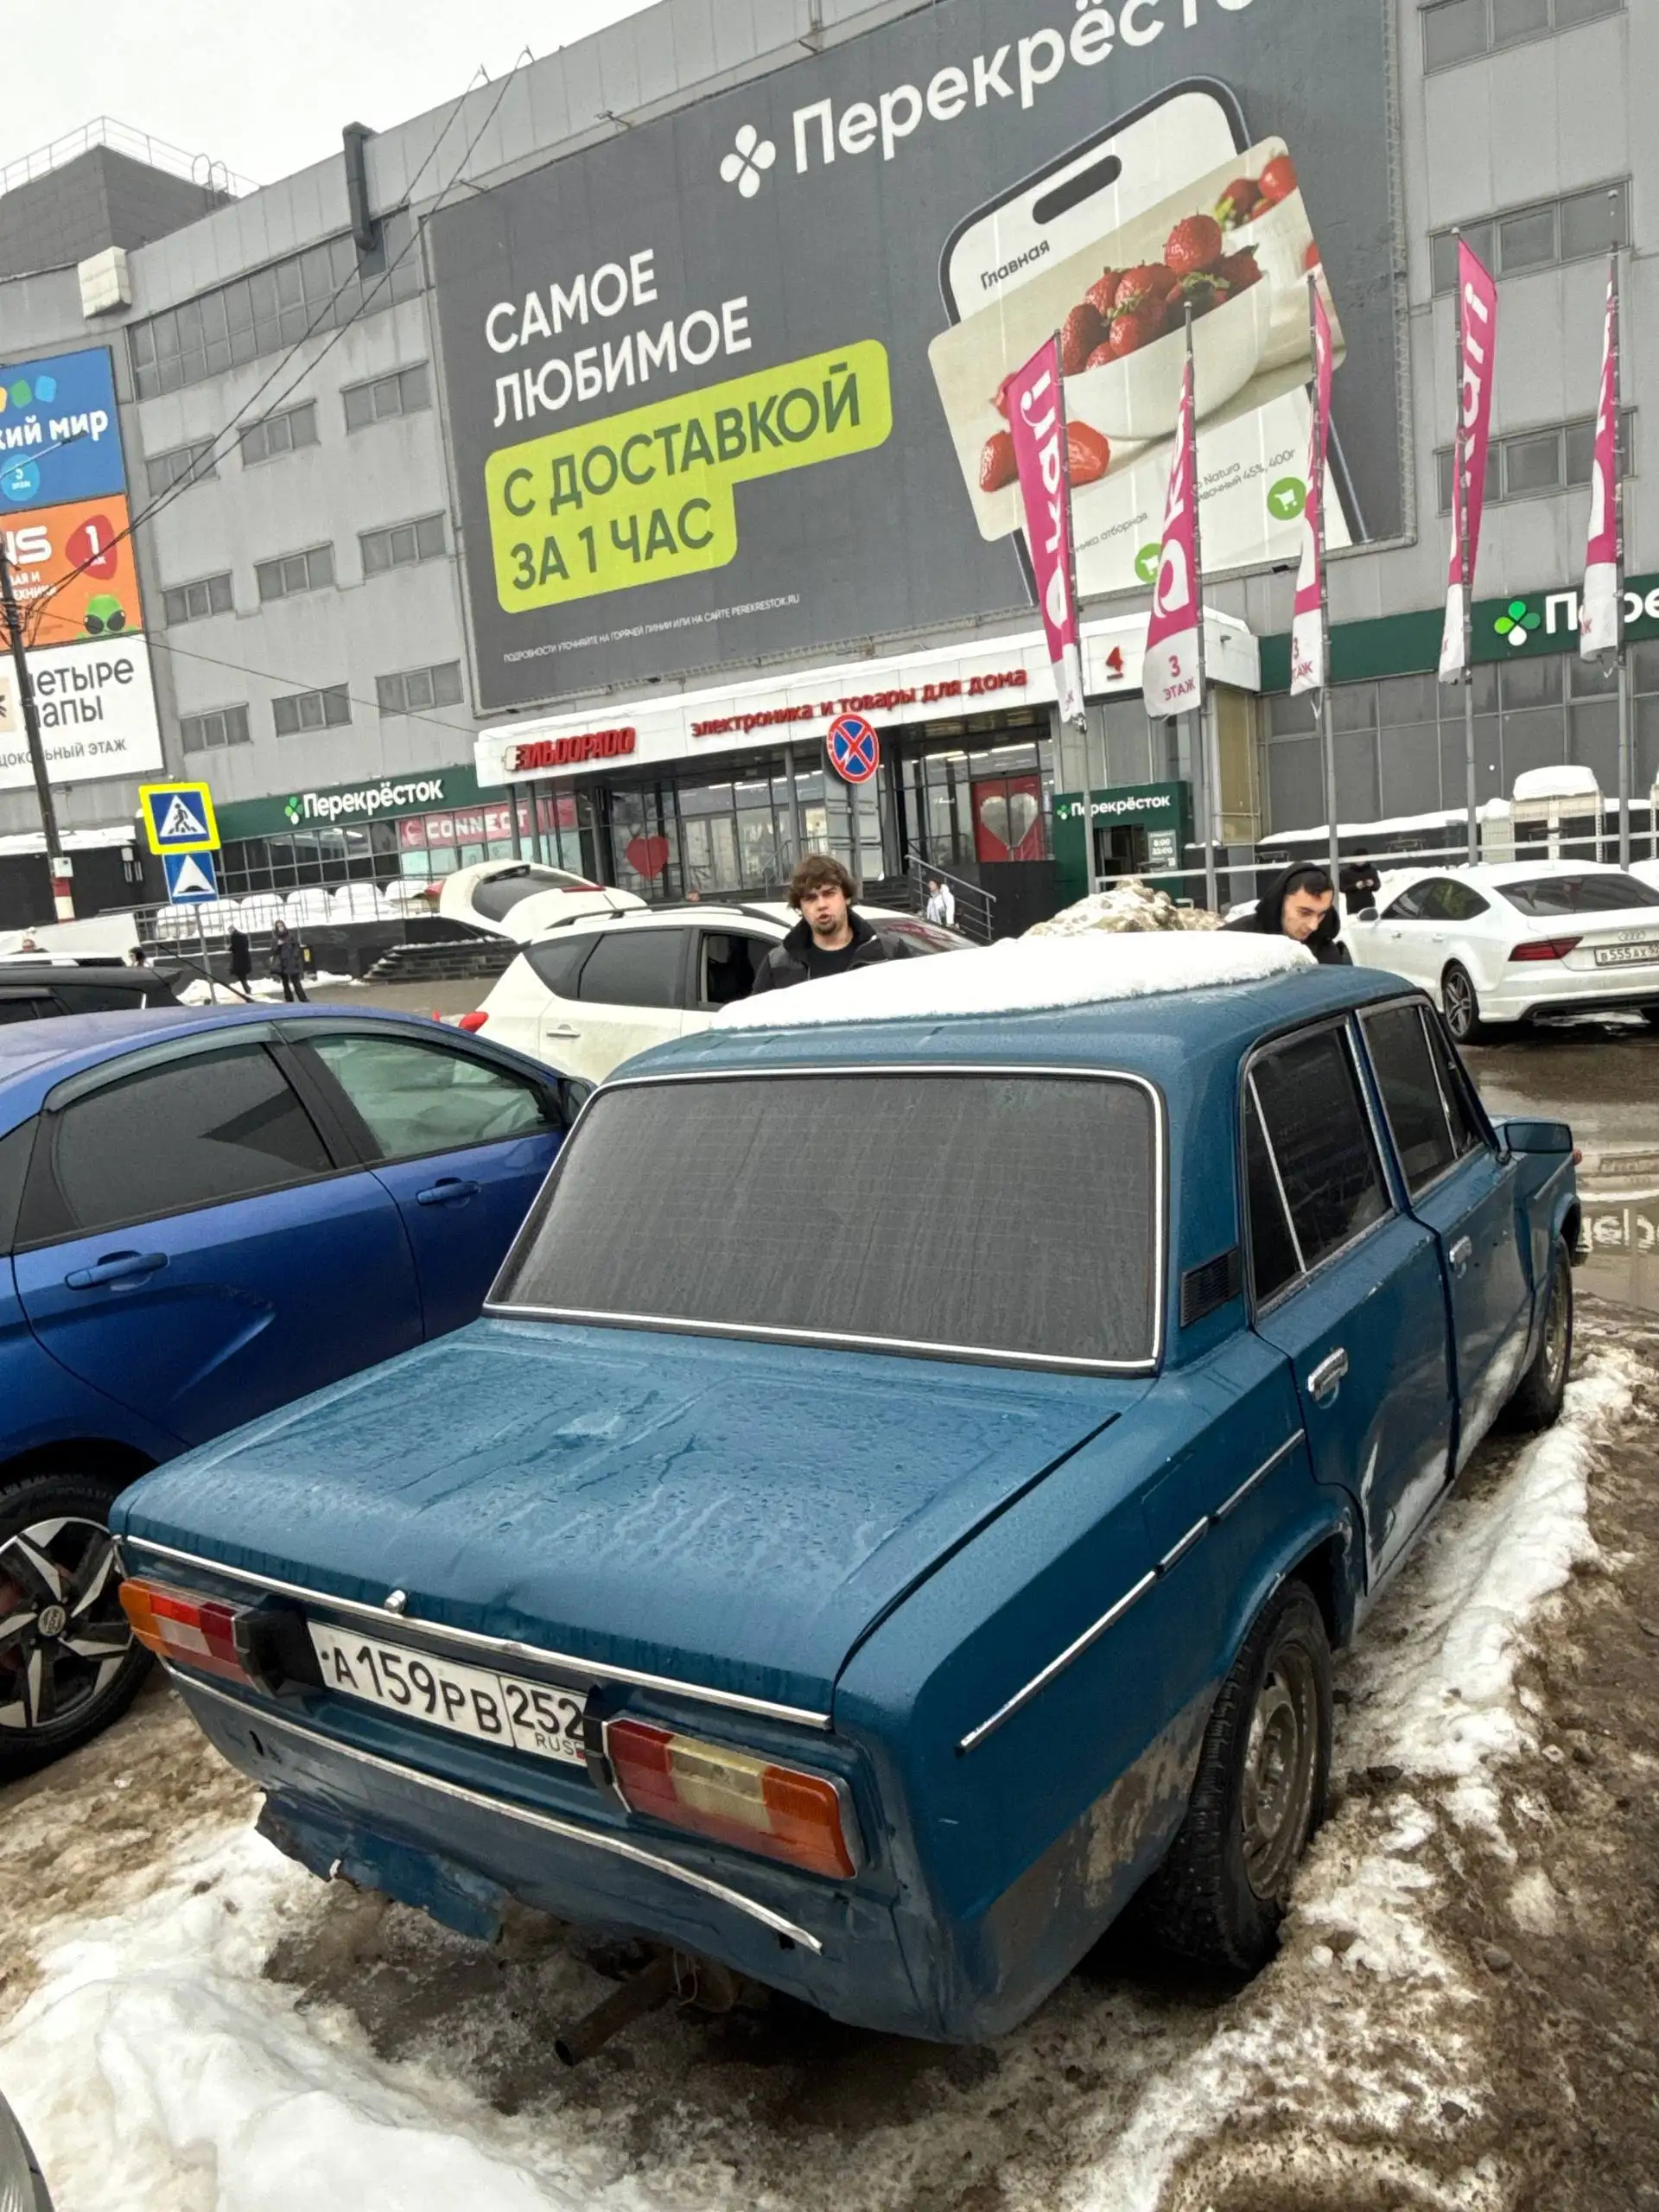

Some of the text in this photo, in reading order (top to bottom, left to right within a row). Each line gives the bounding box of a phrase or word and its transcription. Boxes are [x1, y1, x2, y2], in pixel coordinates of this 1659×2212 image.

[792, 0, 1254, 174] Перекрёс
[980, 239, 1050, 291] Главная
[485, 248, 658, 354] САМОЕ
[493, 296, 753, 429] ЛЮБИМОЕ
[48, 409, 109, 442] мир
[503, 361, 861, 517] С ДОСТАВКОЙ
[510, 497, 715, 591] ЗА 1 ЧАС
[599, 632, 610, 643] НА
[691, 613, 703, 625] НА
[703, 608, 731, 623] САЙТЕ
[731, 593, 800, 617] PEREKRESTOK.RU
[1162, 676, 1197, 702] ЭТАЖ
[1167, 654, 1181, 678] 3
[690, 668, 1028, 738] электроника и товары для дома
[0, 738, 127, 768] ЦОКОЬНЫЙ ЭТАЖ
[517, 726, 637, 770] ЭЛЬДОРАДО
[302, 779, 445, 823] Перекрёсток
[426, 809, 528, 840] CONNECT
[333, 1645, 585, 1740] А159РВ 252
[534, 1732, 575, 1756] RUS
